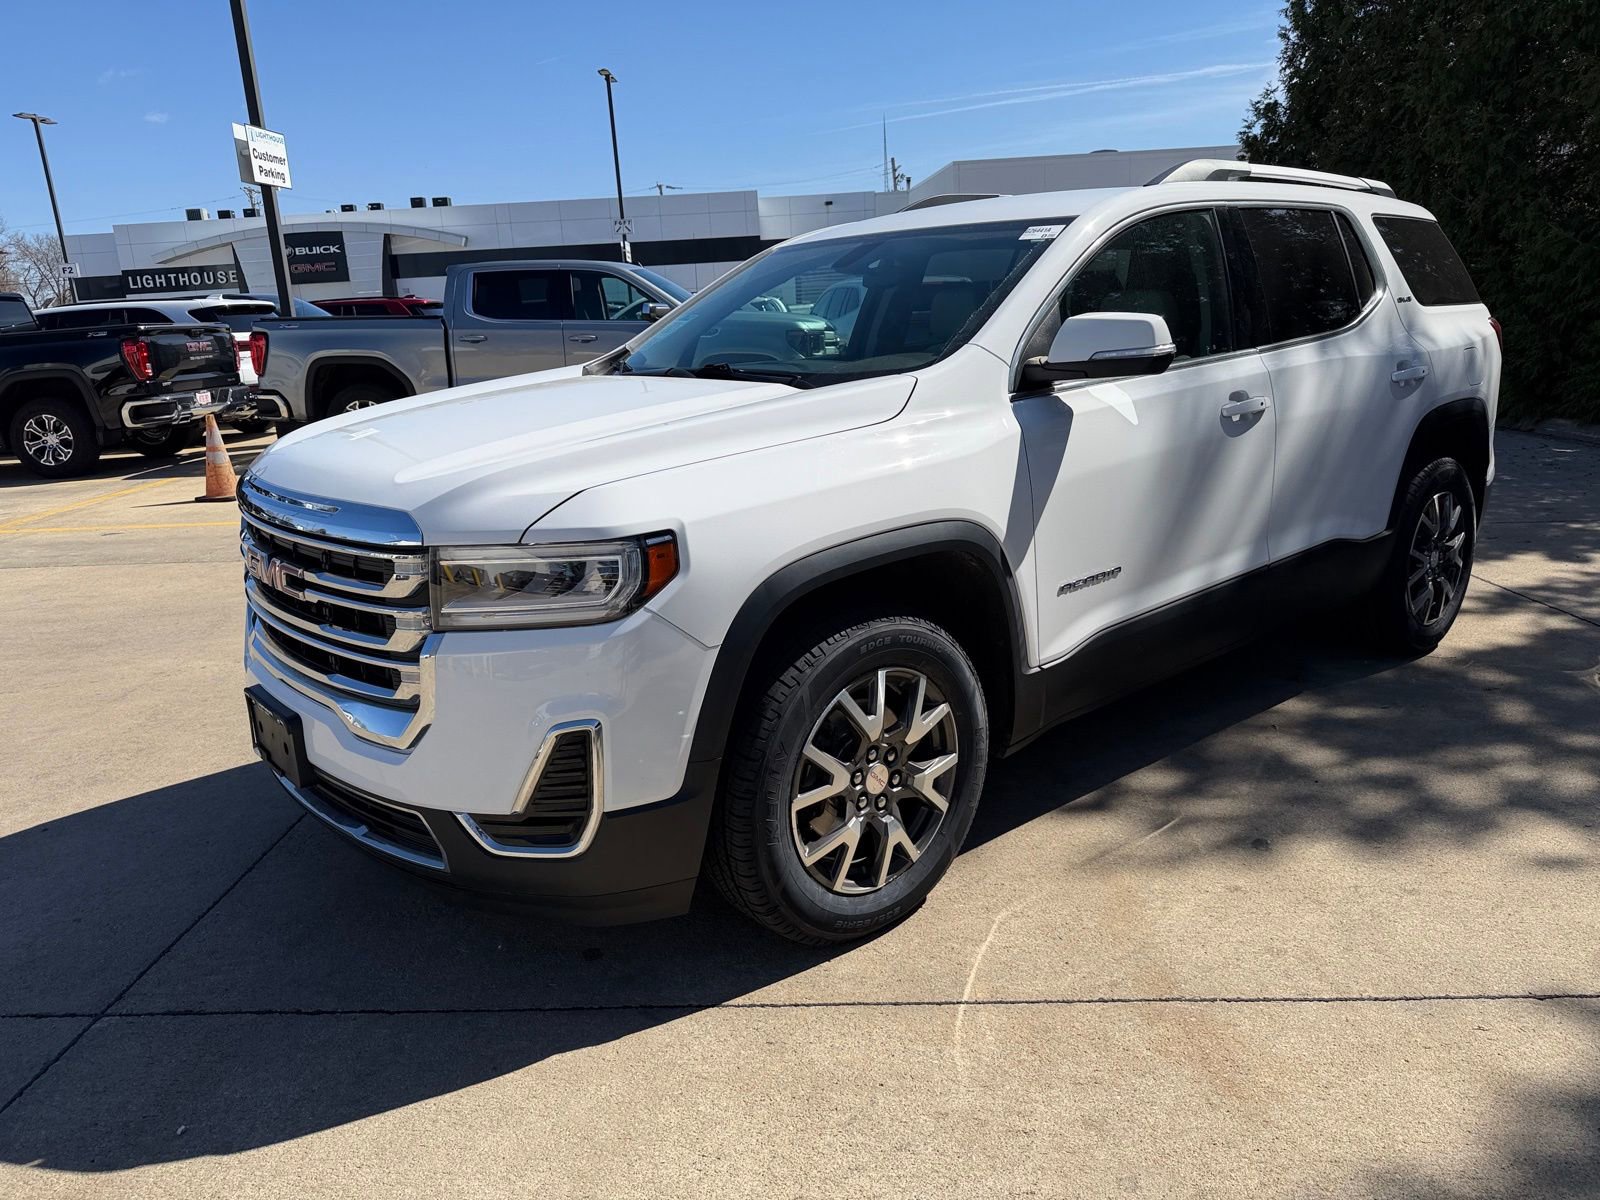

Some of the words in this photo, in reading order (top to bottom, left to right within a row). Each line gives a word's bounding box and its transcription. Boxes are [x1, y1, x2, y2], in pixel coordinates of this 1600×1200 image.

[252, 147, 286, 166] Customer
[258, 164, 286, 184] Parking
[295, 245, 341, 255] BUICK
[62, 266, 74, 275] F2
[290, 261, 337, 274] GMC
[128, 270, 239, 289] LIGHTHOUSE
[246, 544, 306, 602] GMC
[859, 636, 893, 655] EDGE
[898, 634, 944, 654] TOURING
[870, 771, 886, 788] GMC
